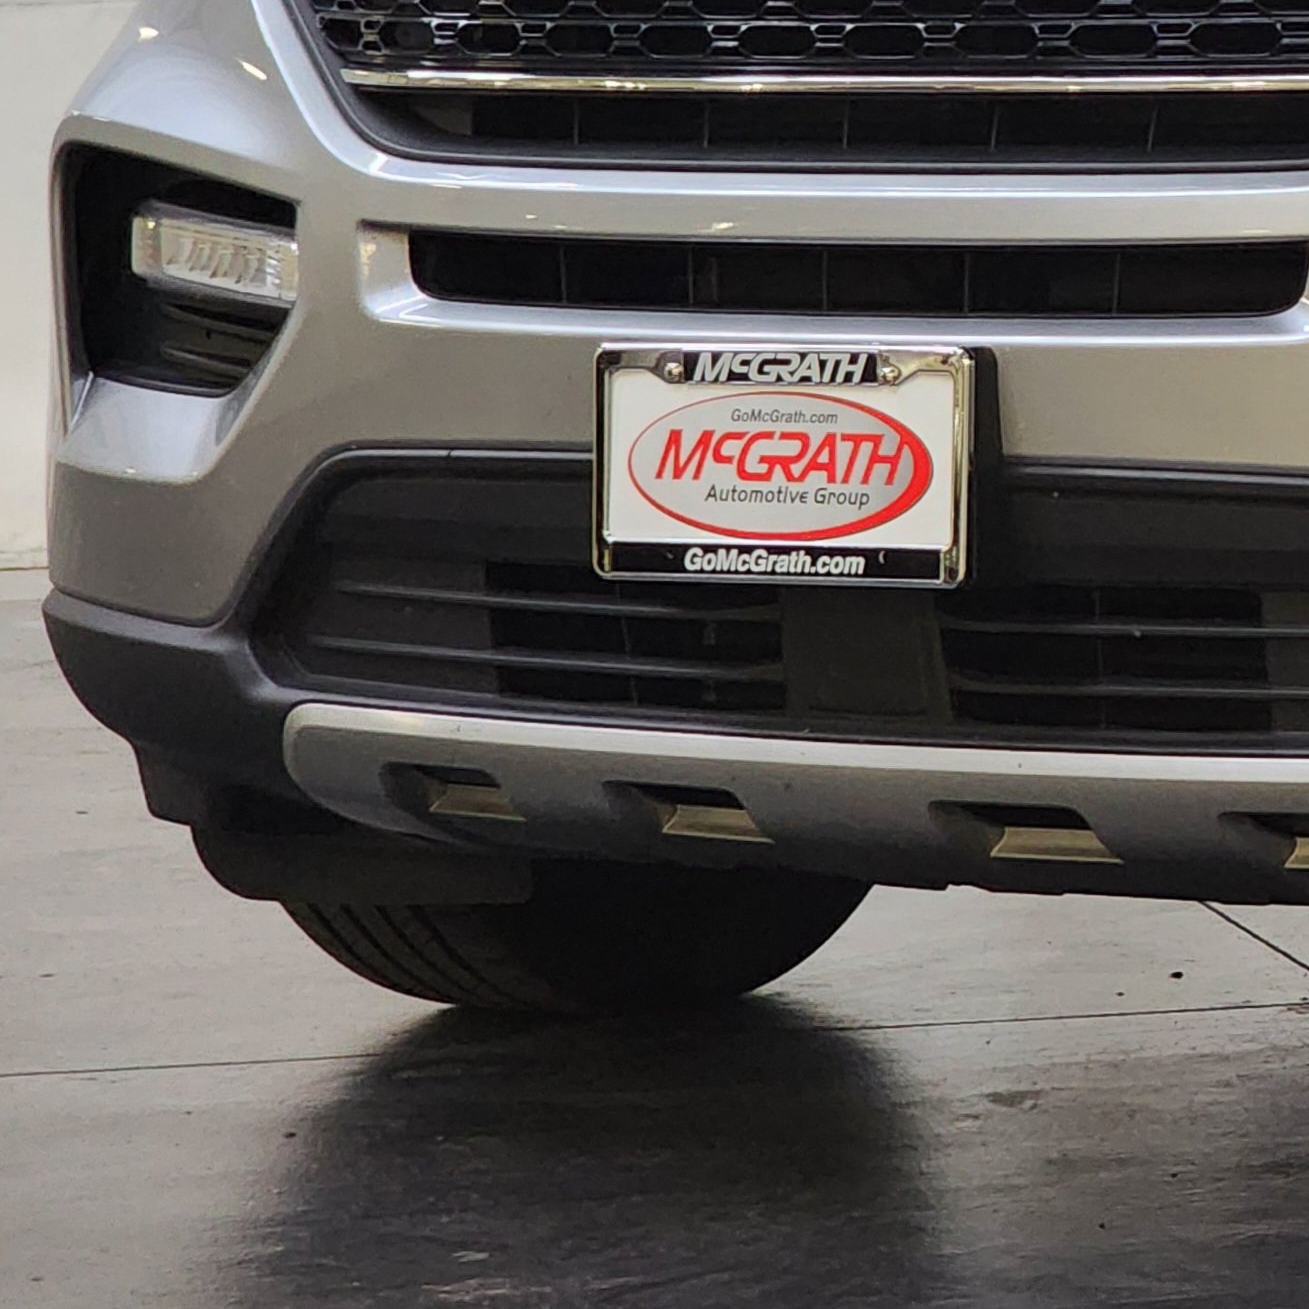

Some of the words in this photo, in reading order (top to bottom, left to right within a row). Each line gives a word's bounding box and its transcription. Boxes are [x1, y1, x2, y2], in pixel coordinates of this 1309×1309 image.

[730, 408, 839, 425] GoMcGrath.com
[704, 484, 809, 505] Automotive
[813, 487, 871, 511] Group
[683, 547, 866, 576] GoMcGrath.com
